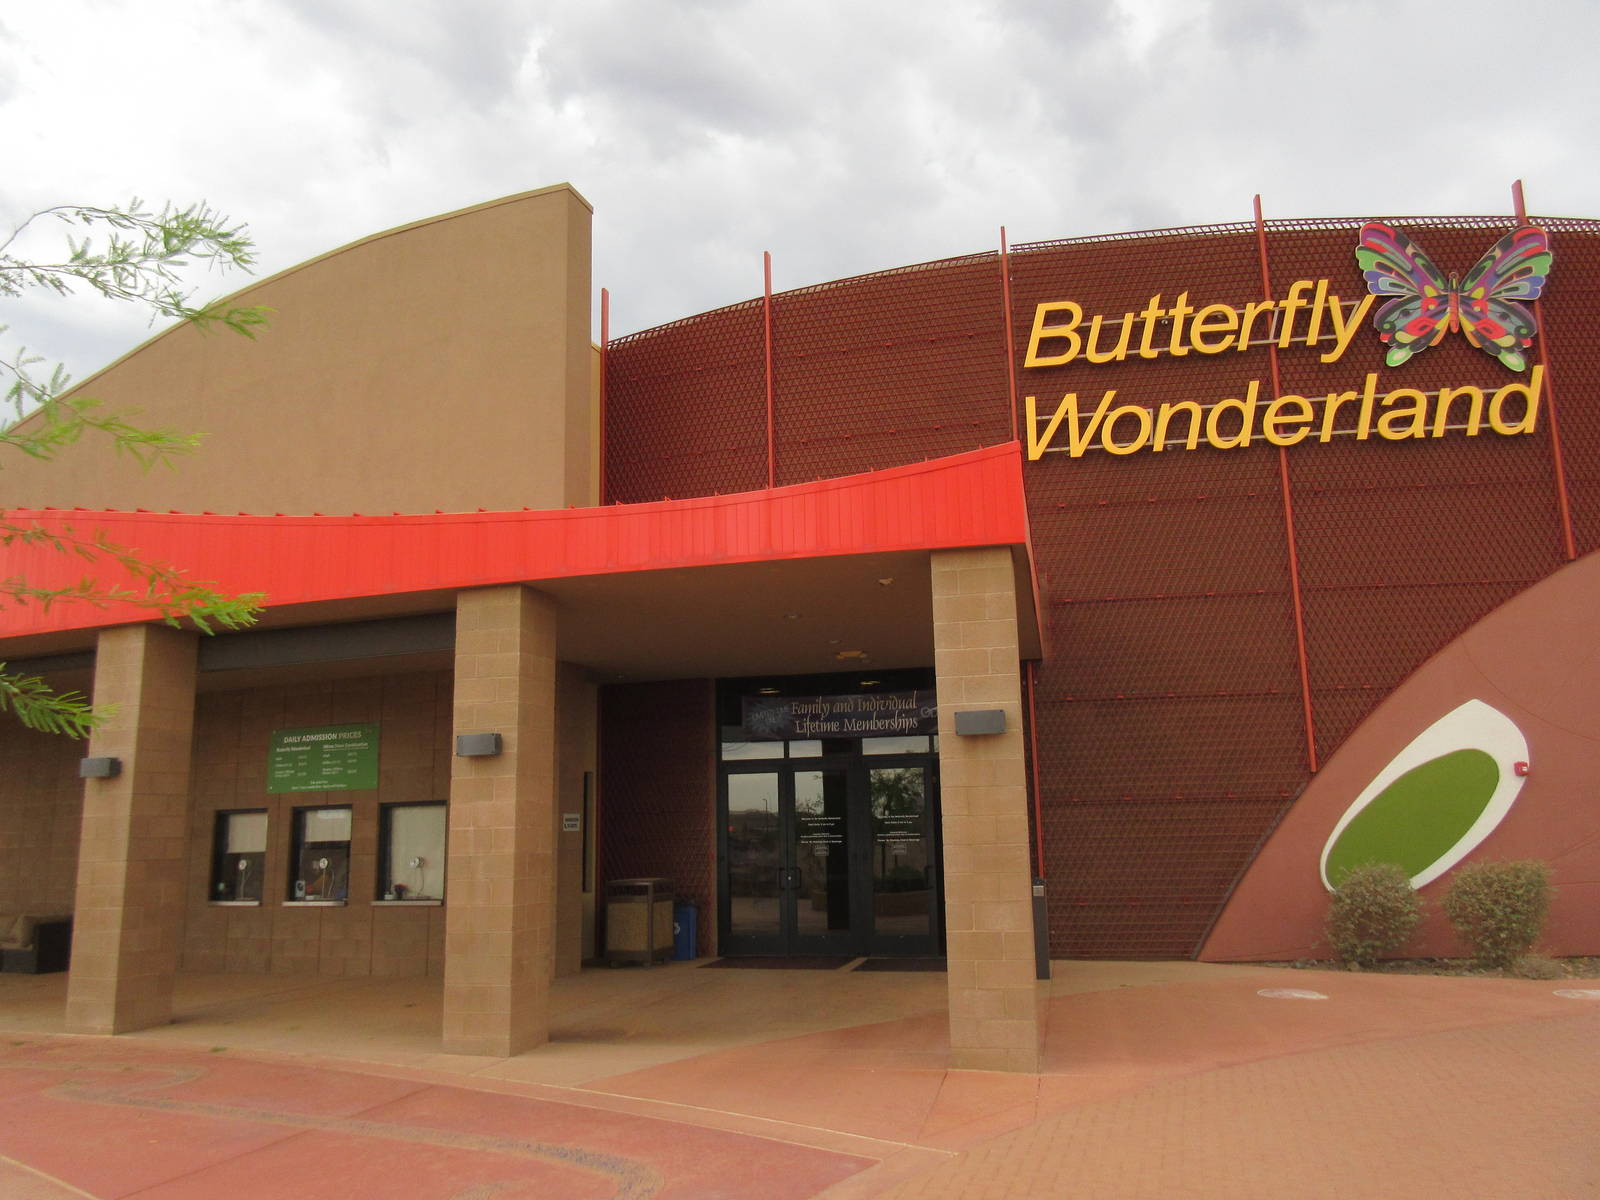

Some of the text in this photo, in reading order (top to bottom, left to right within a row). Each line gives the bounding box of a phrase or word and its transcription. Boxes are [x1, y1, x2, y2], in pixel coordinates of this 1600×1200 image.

[1023, 279, 1377, 368] Butterfly
[1024, 364, 1544, 461] Wonderland
[792, 696, 829, 720] Family
[832, 701, 852, 713] and
[858, 690, 918, 712] Individual
[284, 731, 362, 744] DAILY ADMISSION PRICES
[795, 714, 840, 739] Lifetime
[843, 710, 918, 736] Memberships
